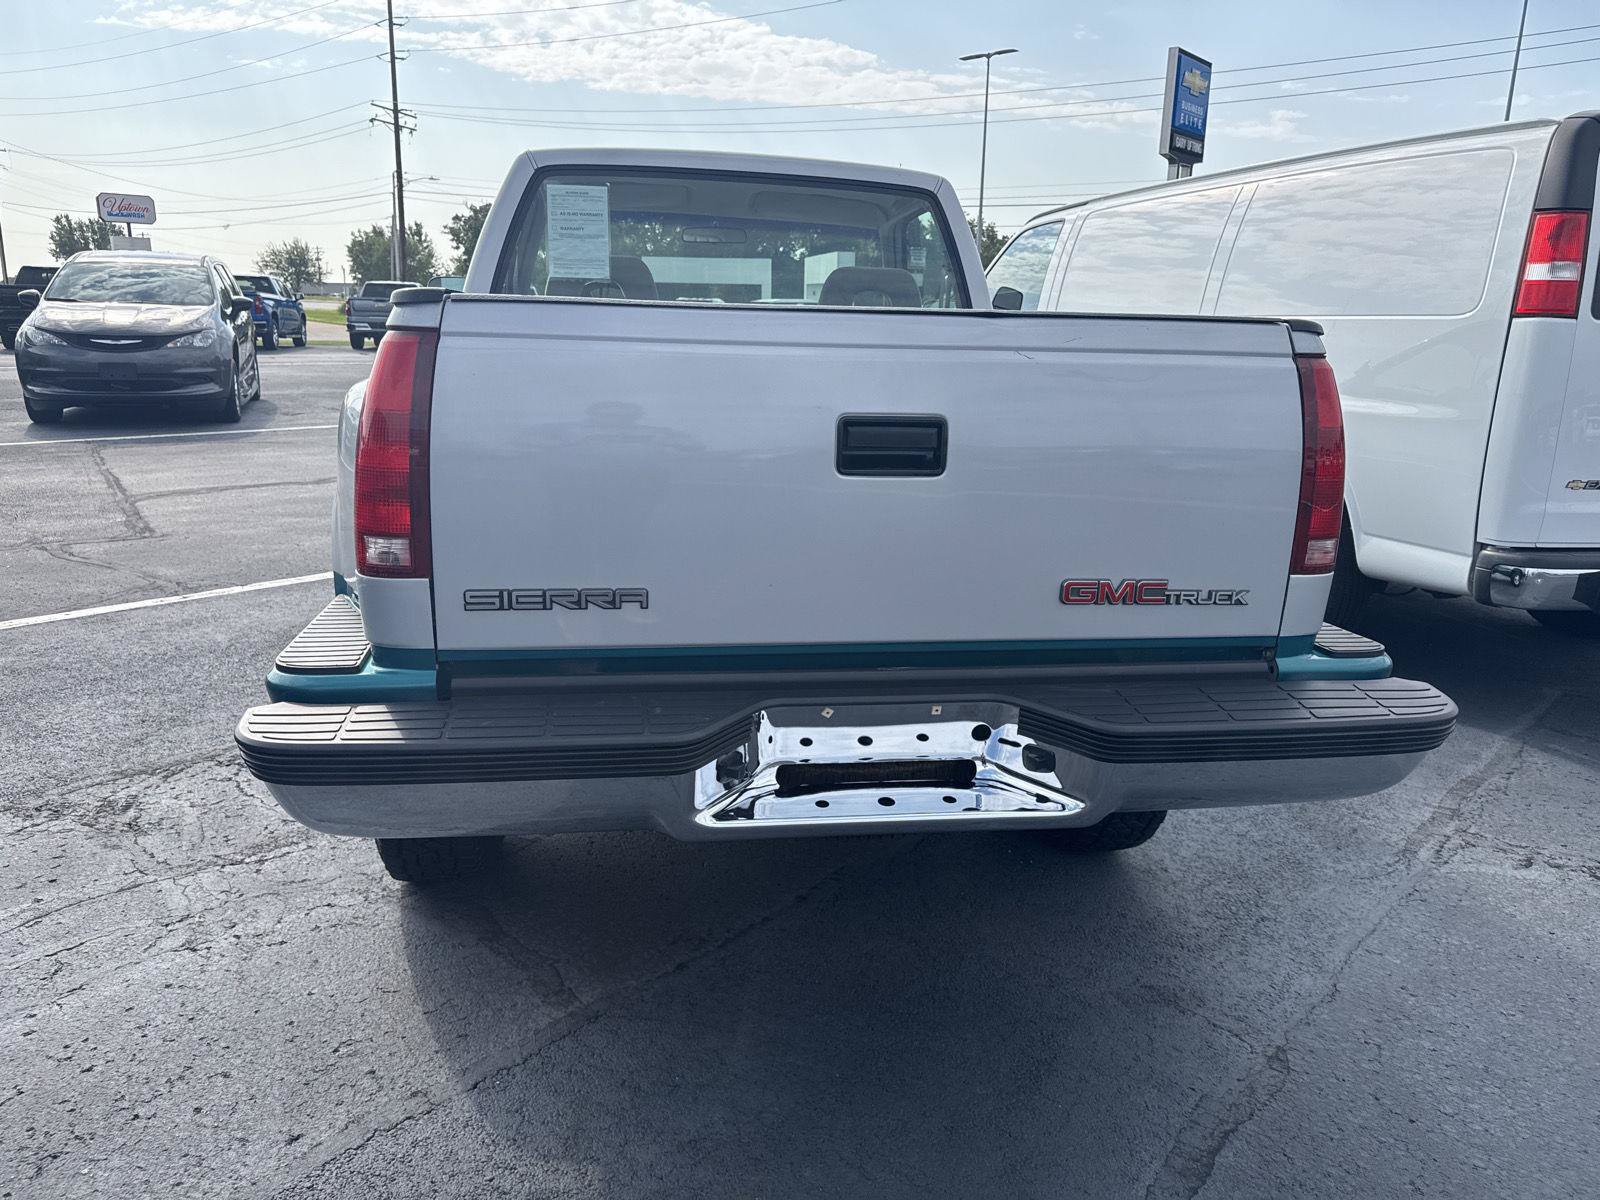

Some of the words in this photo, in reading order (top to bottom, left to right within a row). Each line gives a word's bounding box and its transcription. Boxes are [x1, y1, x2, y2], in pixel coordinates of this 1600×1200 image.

[1181, 100, 1204, 115] BUSINESS
[1180, 113, 1203, 129] ELITE
[102, 196, 151, 213] Uptown
[463, 587, 649, 611] SIERRA
[1059, 578, 1168, 606] GMC
[1164, 589, 1250, 606] TRUCK
